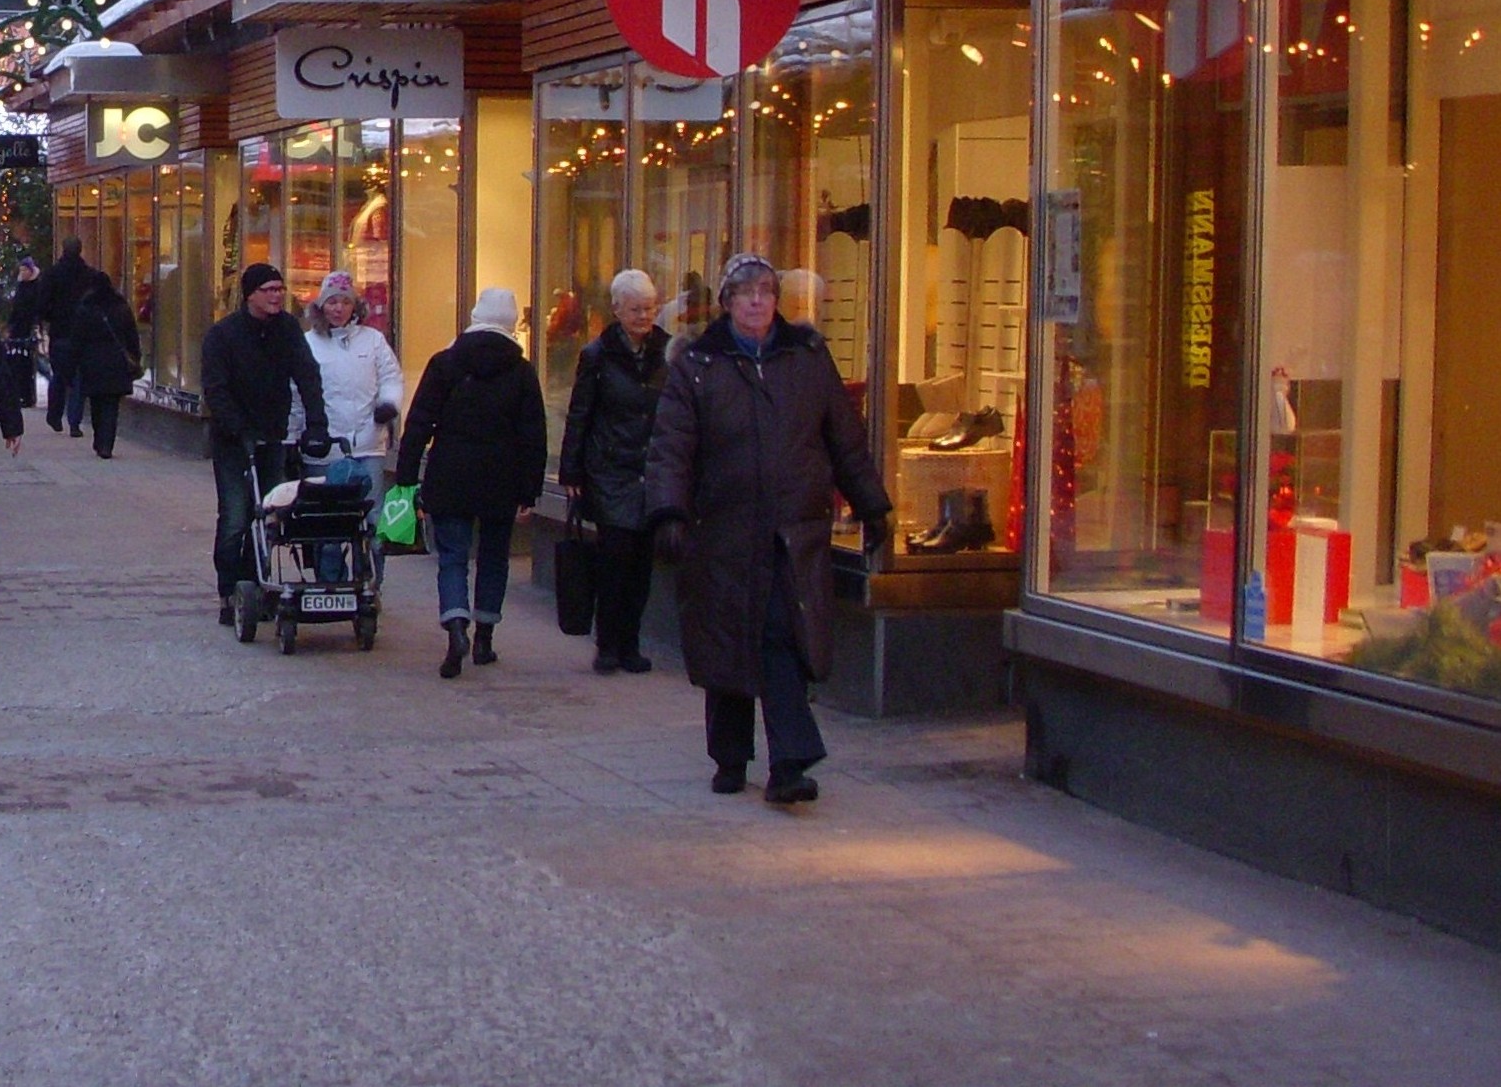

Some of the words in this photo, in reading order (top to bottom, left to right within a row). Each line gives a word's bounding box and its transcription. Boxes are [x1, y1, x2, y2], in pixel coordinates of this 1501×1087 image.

[293, 45, 449, 111] Crispin
[95, 106, 171, 160] JC
[303, 596, 346, 610] EGON
